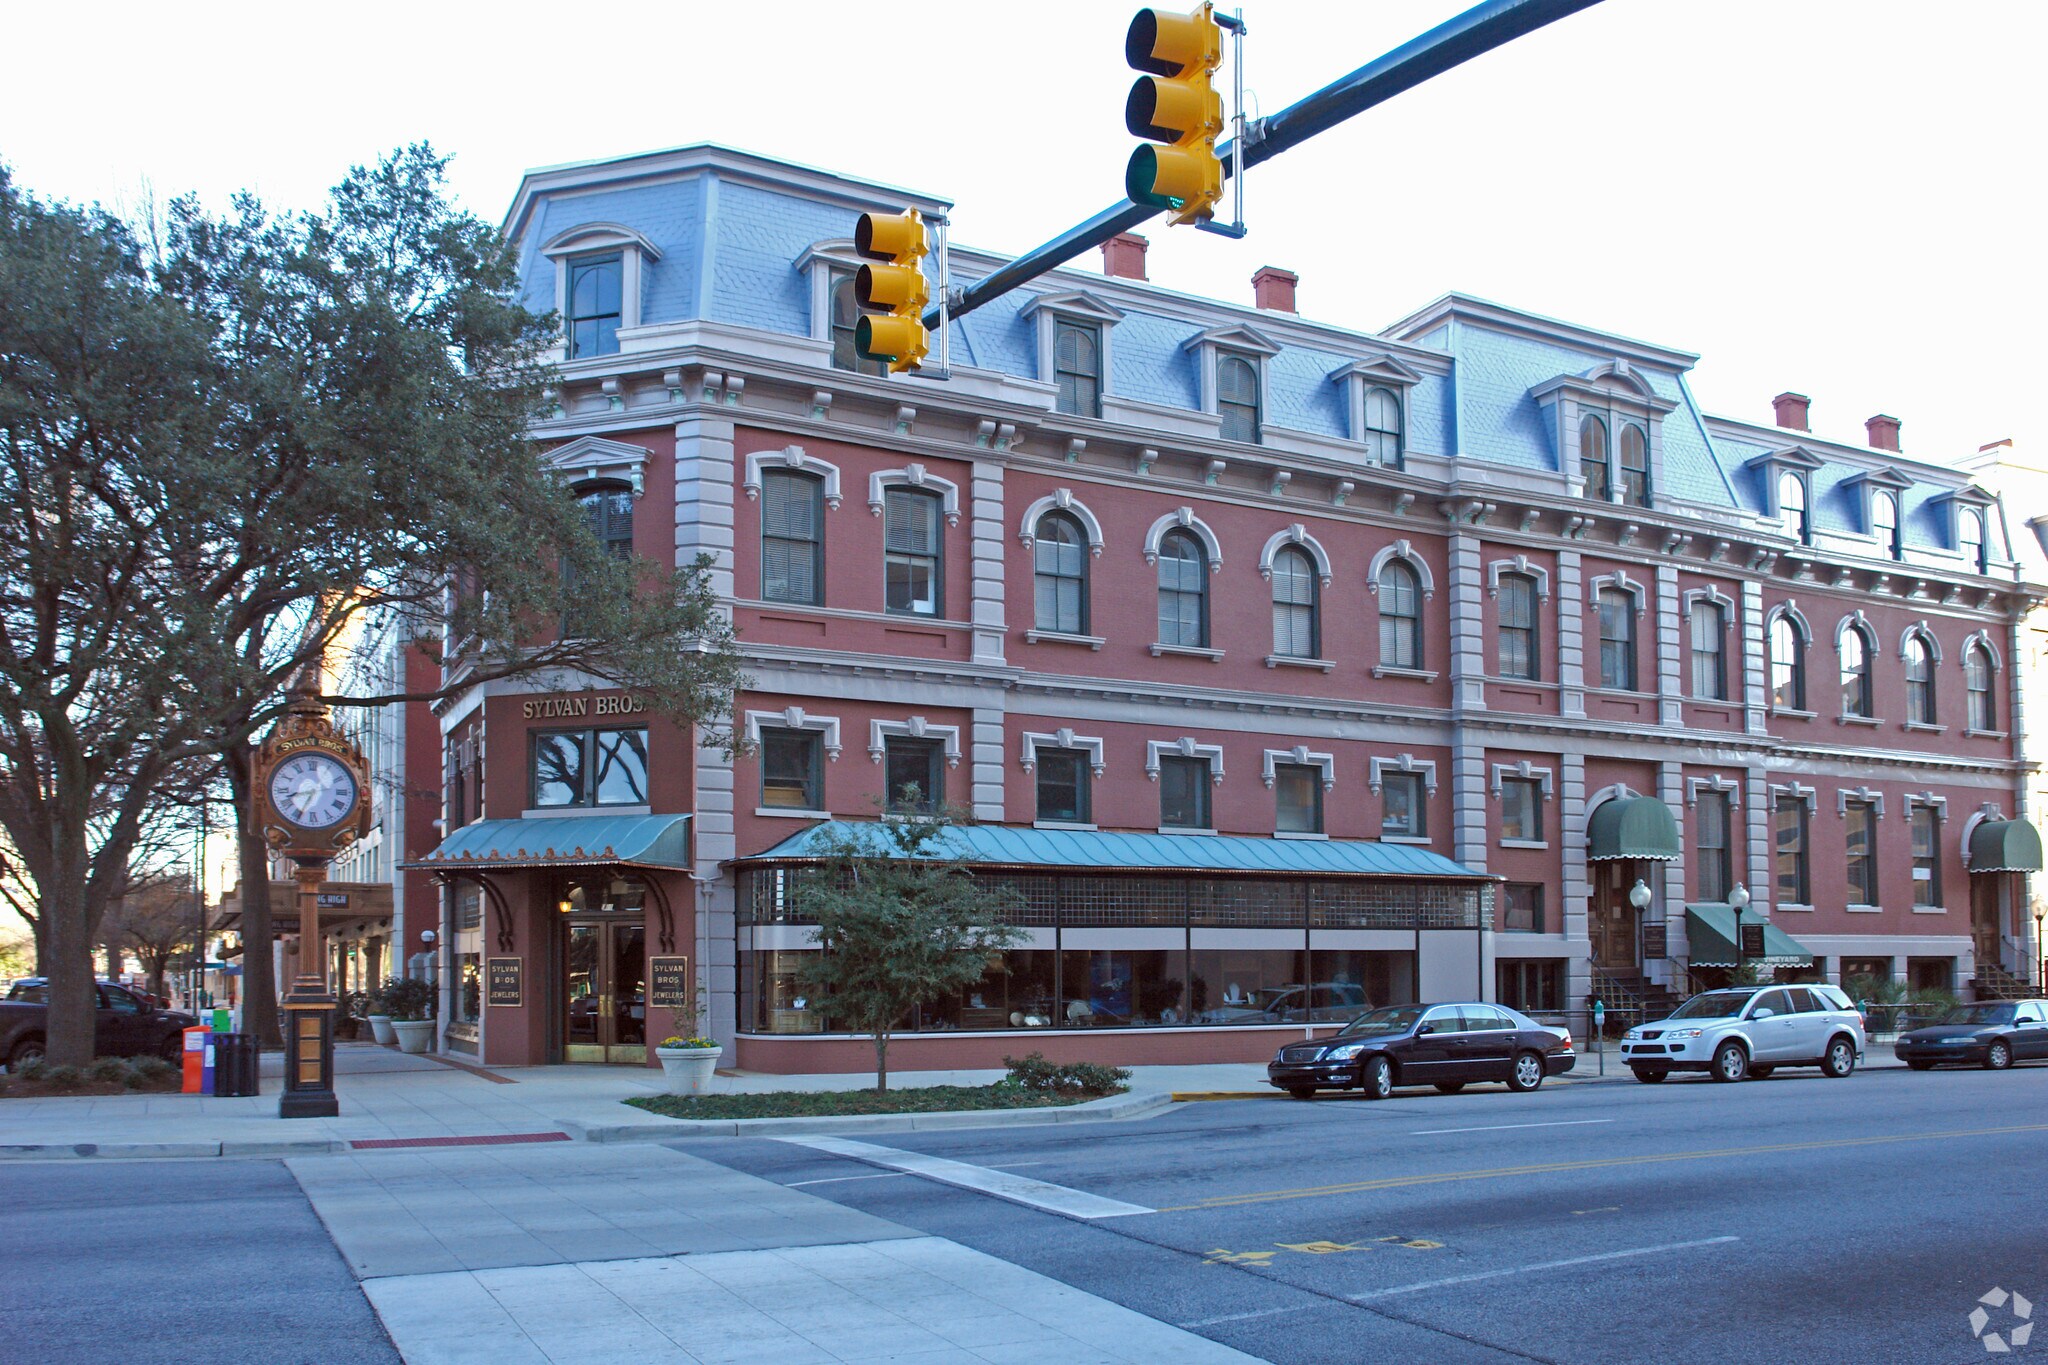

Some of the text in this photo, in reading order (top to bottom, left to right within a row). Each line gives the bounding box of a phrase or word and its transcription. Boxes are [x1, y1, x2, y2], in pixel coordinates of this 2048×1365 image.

[523, 697, 588, 719] SYLVAN
[281, 738, 315, 750] SYLVAN
[328, 895, 346, 903] HIGH
[491, 965, 519, 973] SYLVAN
[654, 964, 684, 973] SYLVAN
[657, 976, 680, 984] BROS
[490, 991, 519, 999] JEWELERS
[652, 991, 684, 999] JEWELERS
